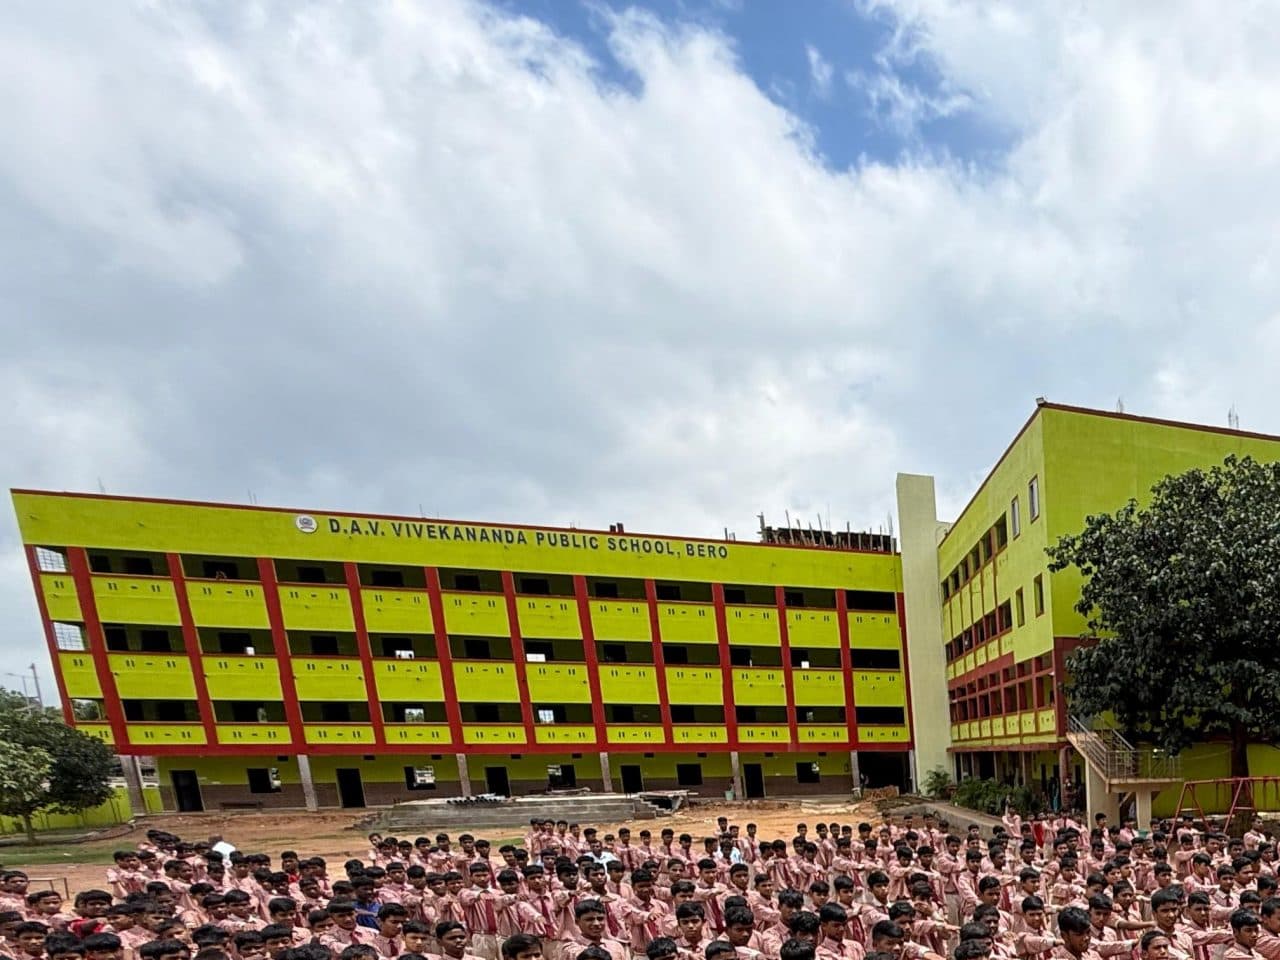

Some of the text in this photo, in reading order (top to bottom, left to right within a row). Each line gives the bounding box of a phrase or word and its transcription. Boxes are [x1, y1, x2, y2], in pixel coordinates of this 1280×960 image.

[328, 518, 728, 559] D.A.V. VIVEKANANDA PUBLIC SCHOOL, BERO
